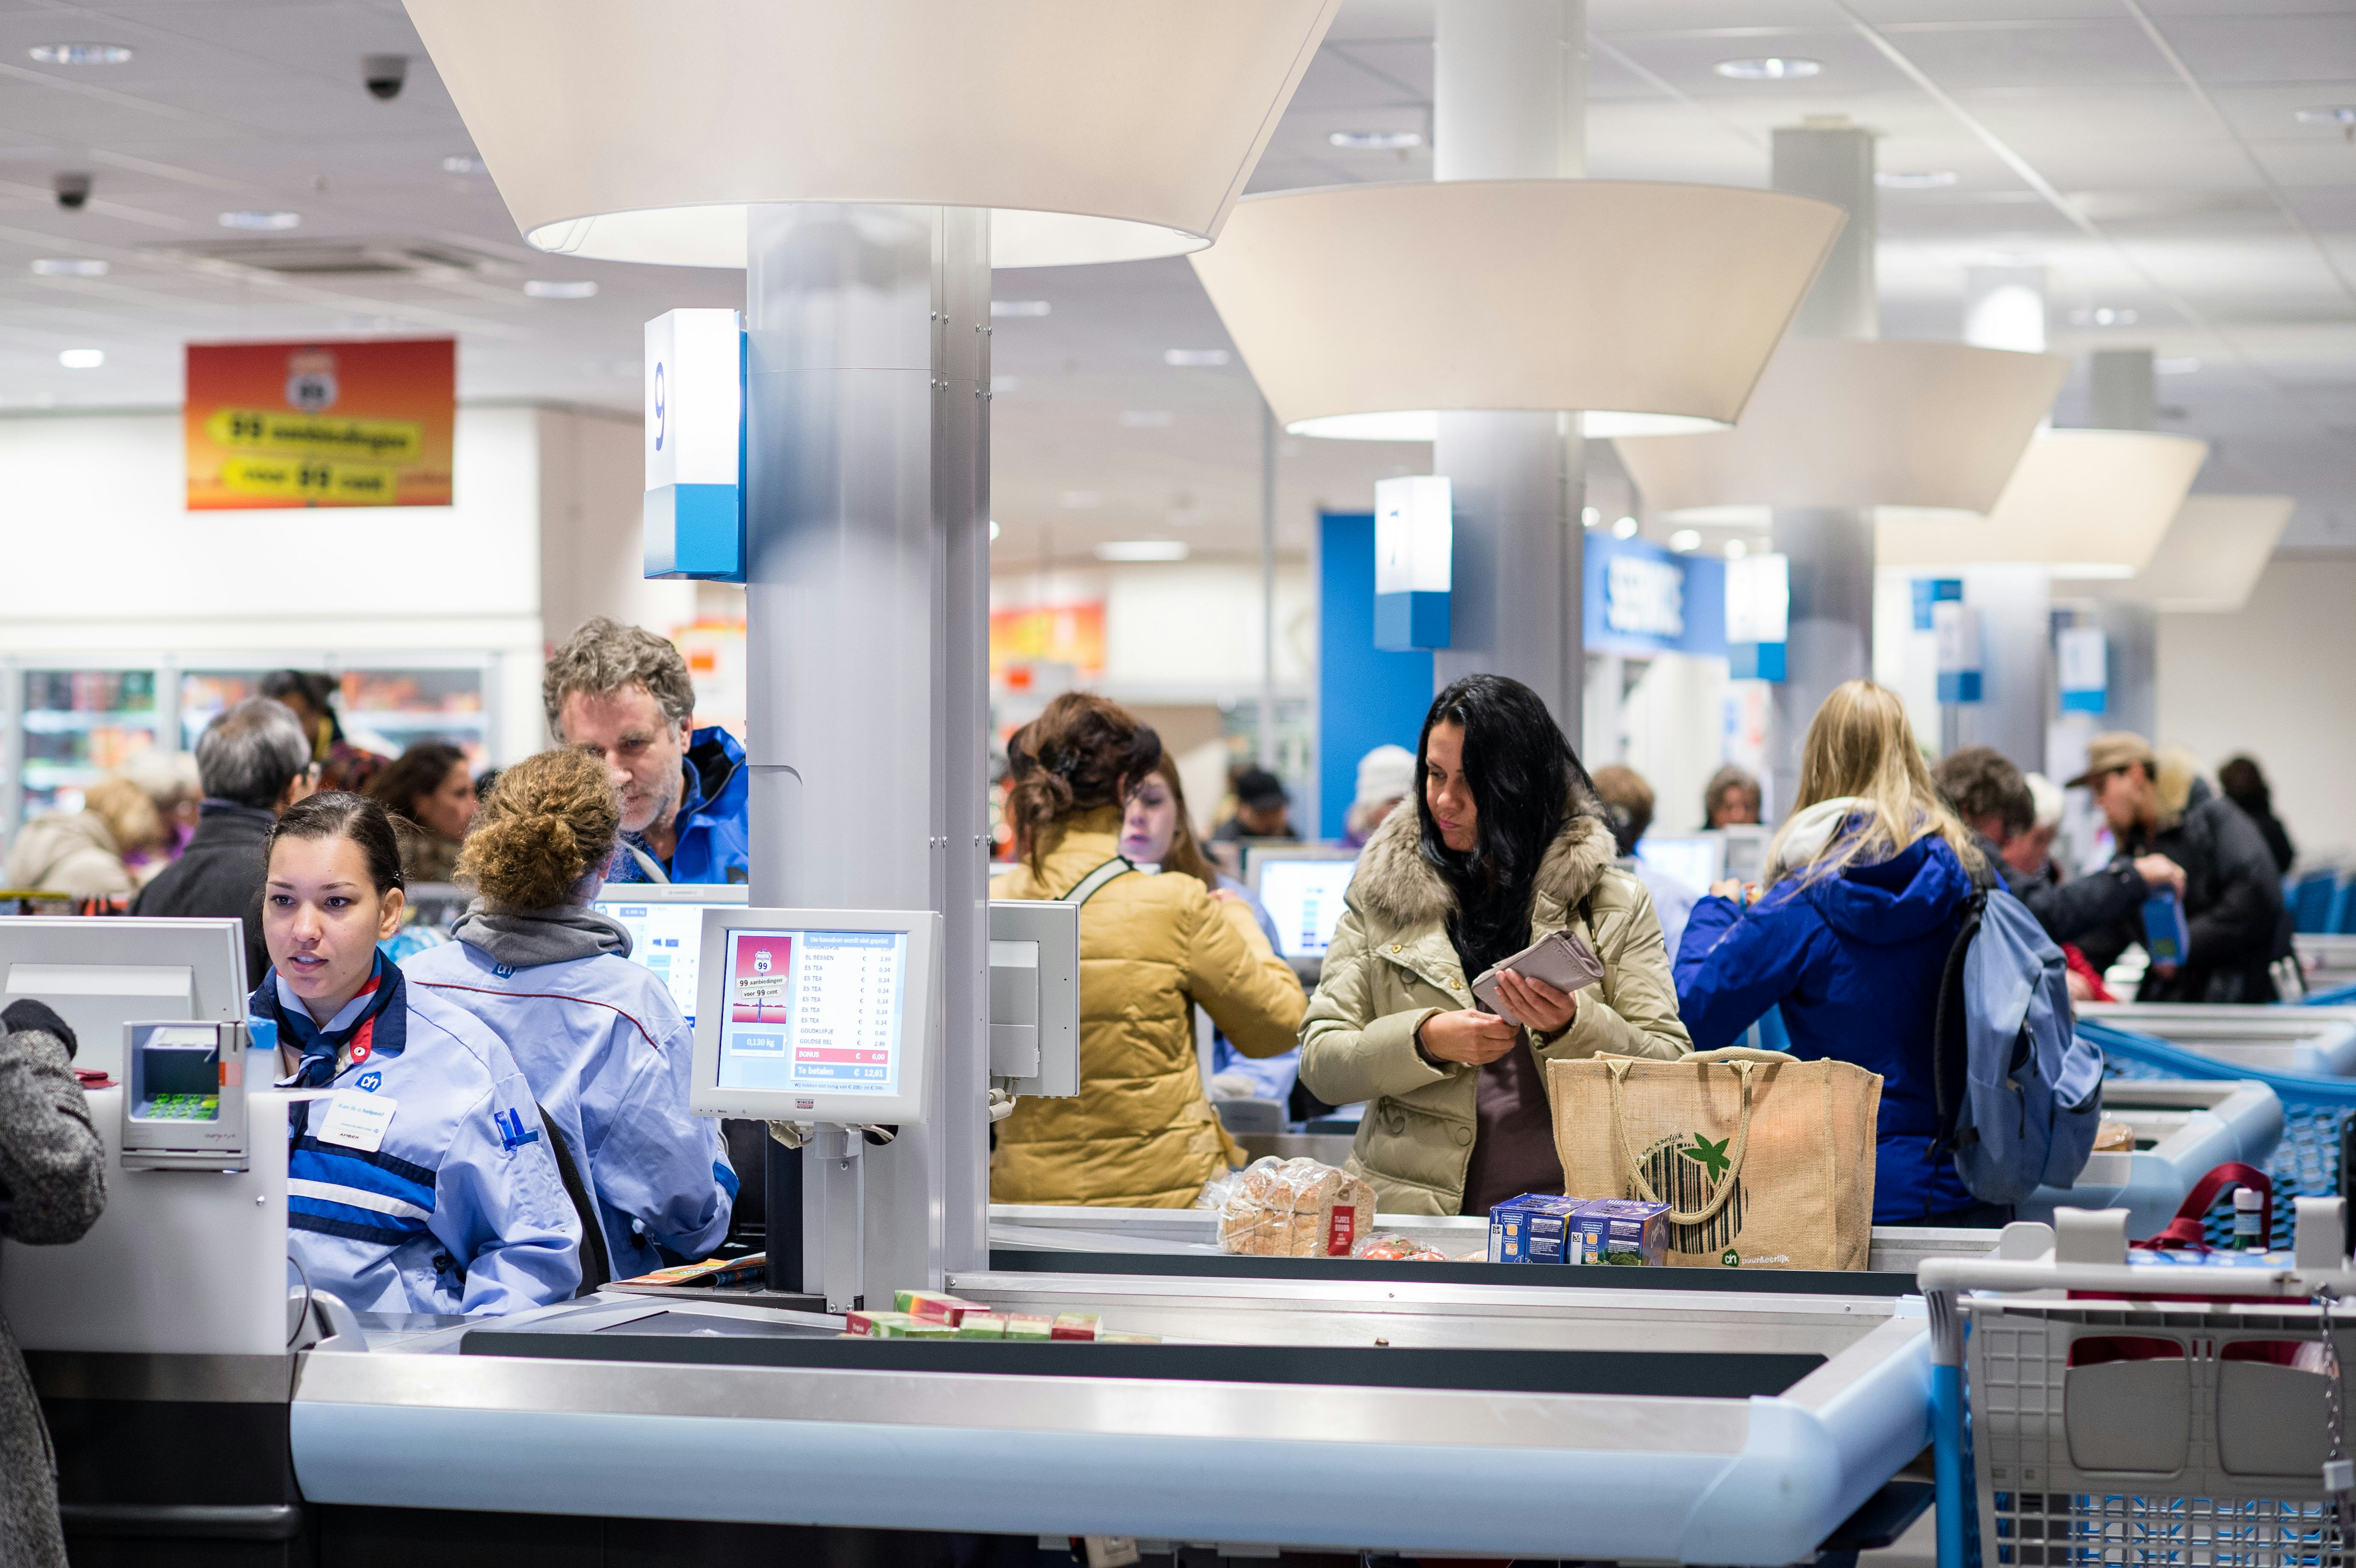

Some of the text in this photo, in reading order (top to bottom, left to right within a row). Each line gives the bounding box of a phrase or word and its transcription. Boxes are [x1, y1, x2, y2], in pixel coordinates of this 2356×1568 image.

[655, 362, 665, 451] 9
[747, 1039, 774, 1048] 0,130 kg
[808, 1067, 834, 1076] betalen
[864, 1069, 884, 1078] 12,61
[362, 1108, 384, 1117] helpen?
[1741, 1254, 1789, 1265] puur&eerlijk
